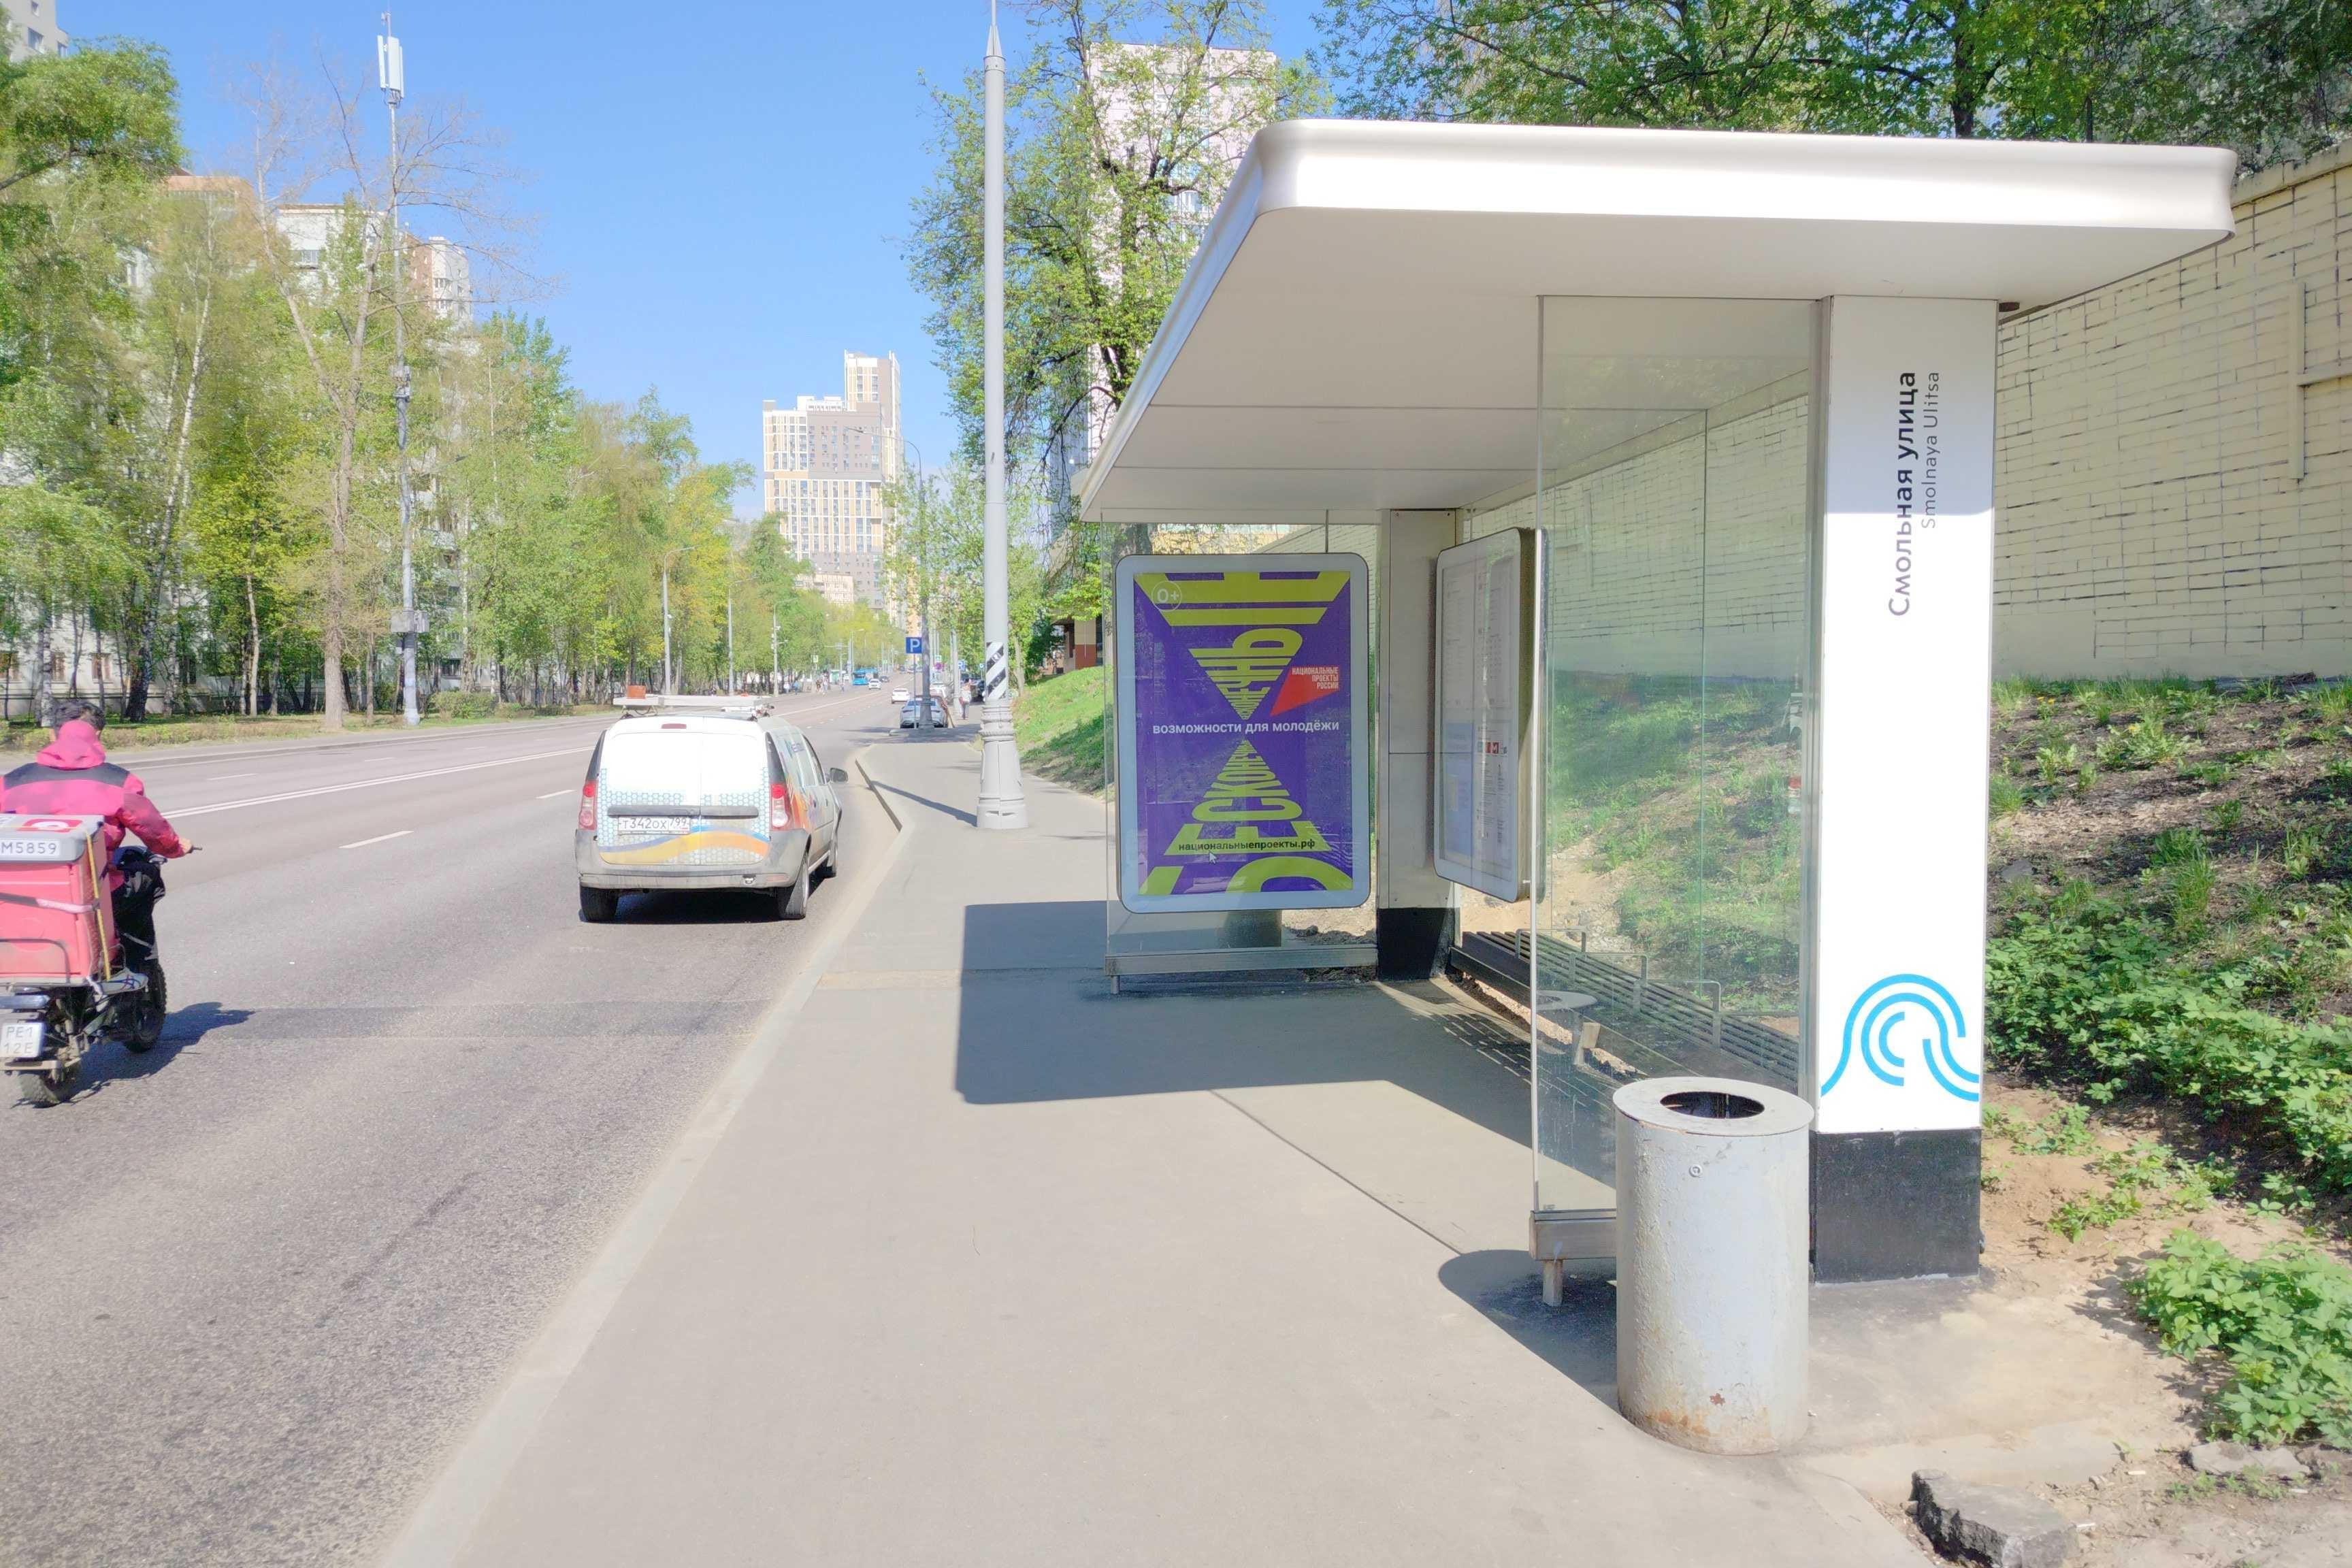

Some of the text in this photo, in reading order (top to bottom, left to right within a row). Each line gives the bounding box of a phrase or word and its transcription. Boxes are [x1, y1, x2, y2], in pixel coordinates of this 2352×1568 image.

[1921, 372, 1940, 529] Smolnaya Ulitsa
[1888, 372, 1918, 616] Смольная улица
[1157, 589, 1179, 602] 0+
[910, 638, 920, 653] P
[1292, 667, 1339, 675] НАЦИОНАЛЬНЫЕ
[1317, 681, 1339, 689] РОССИИ
[1178, 838, 1316, 851] национальныепроекты.рф
